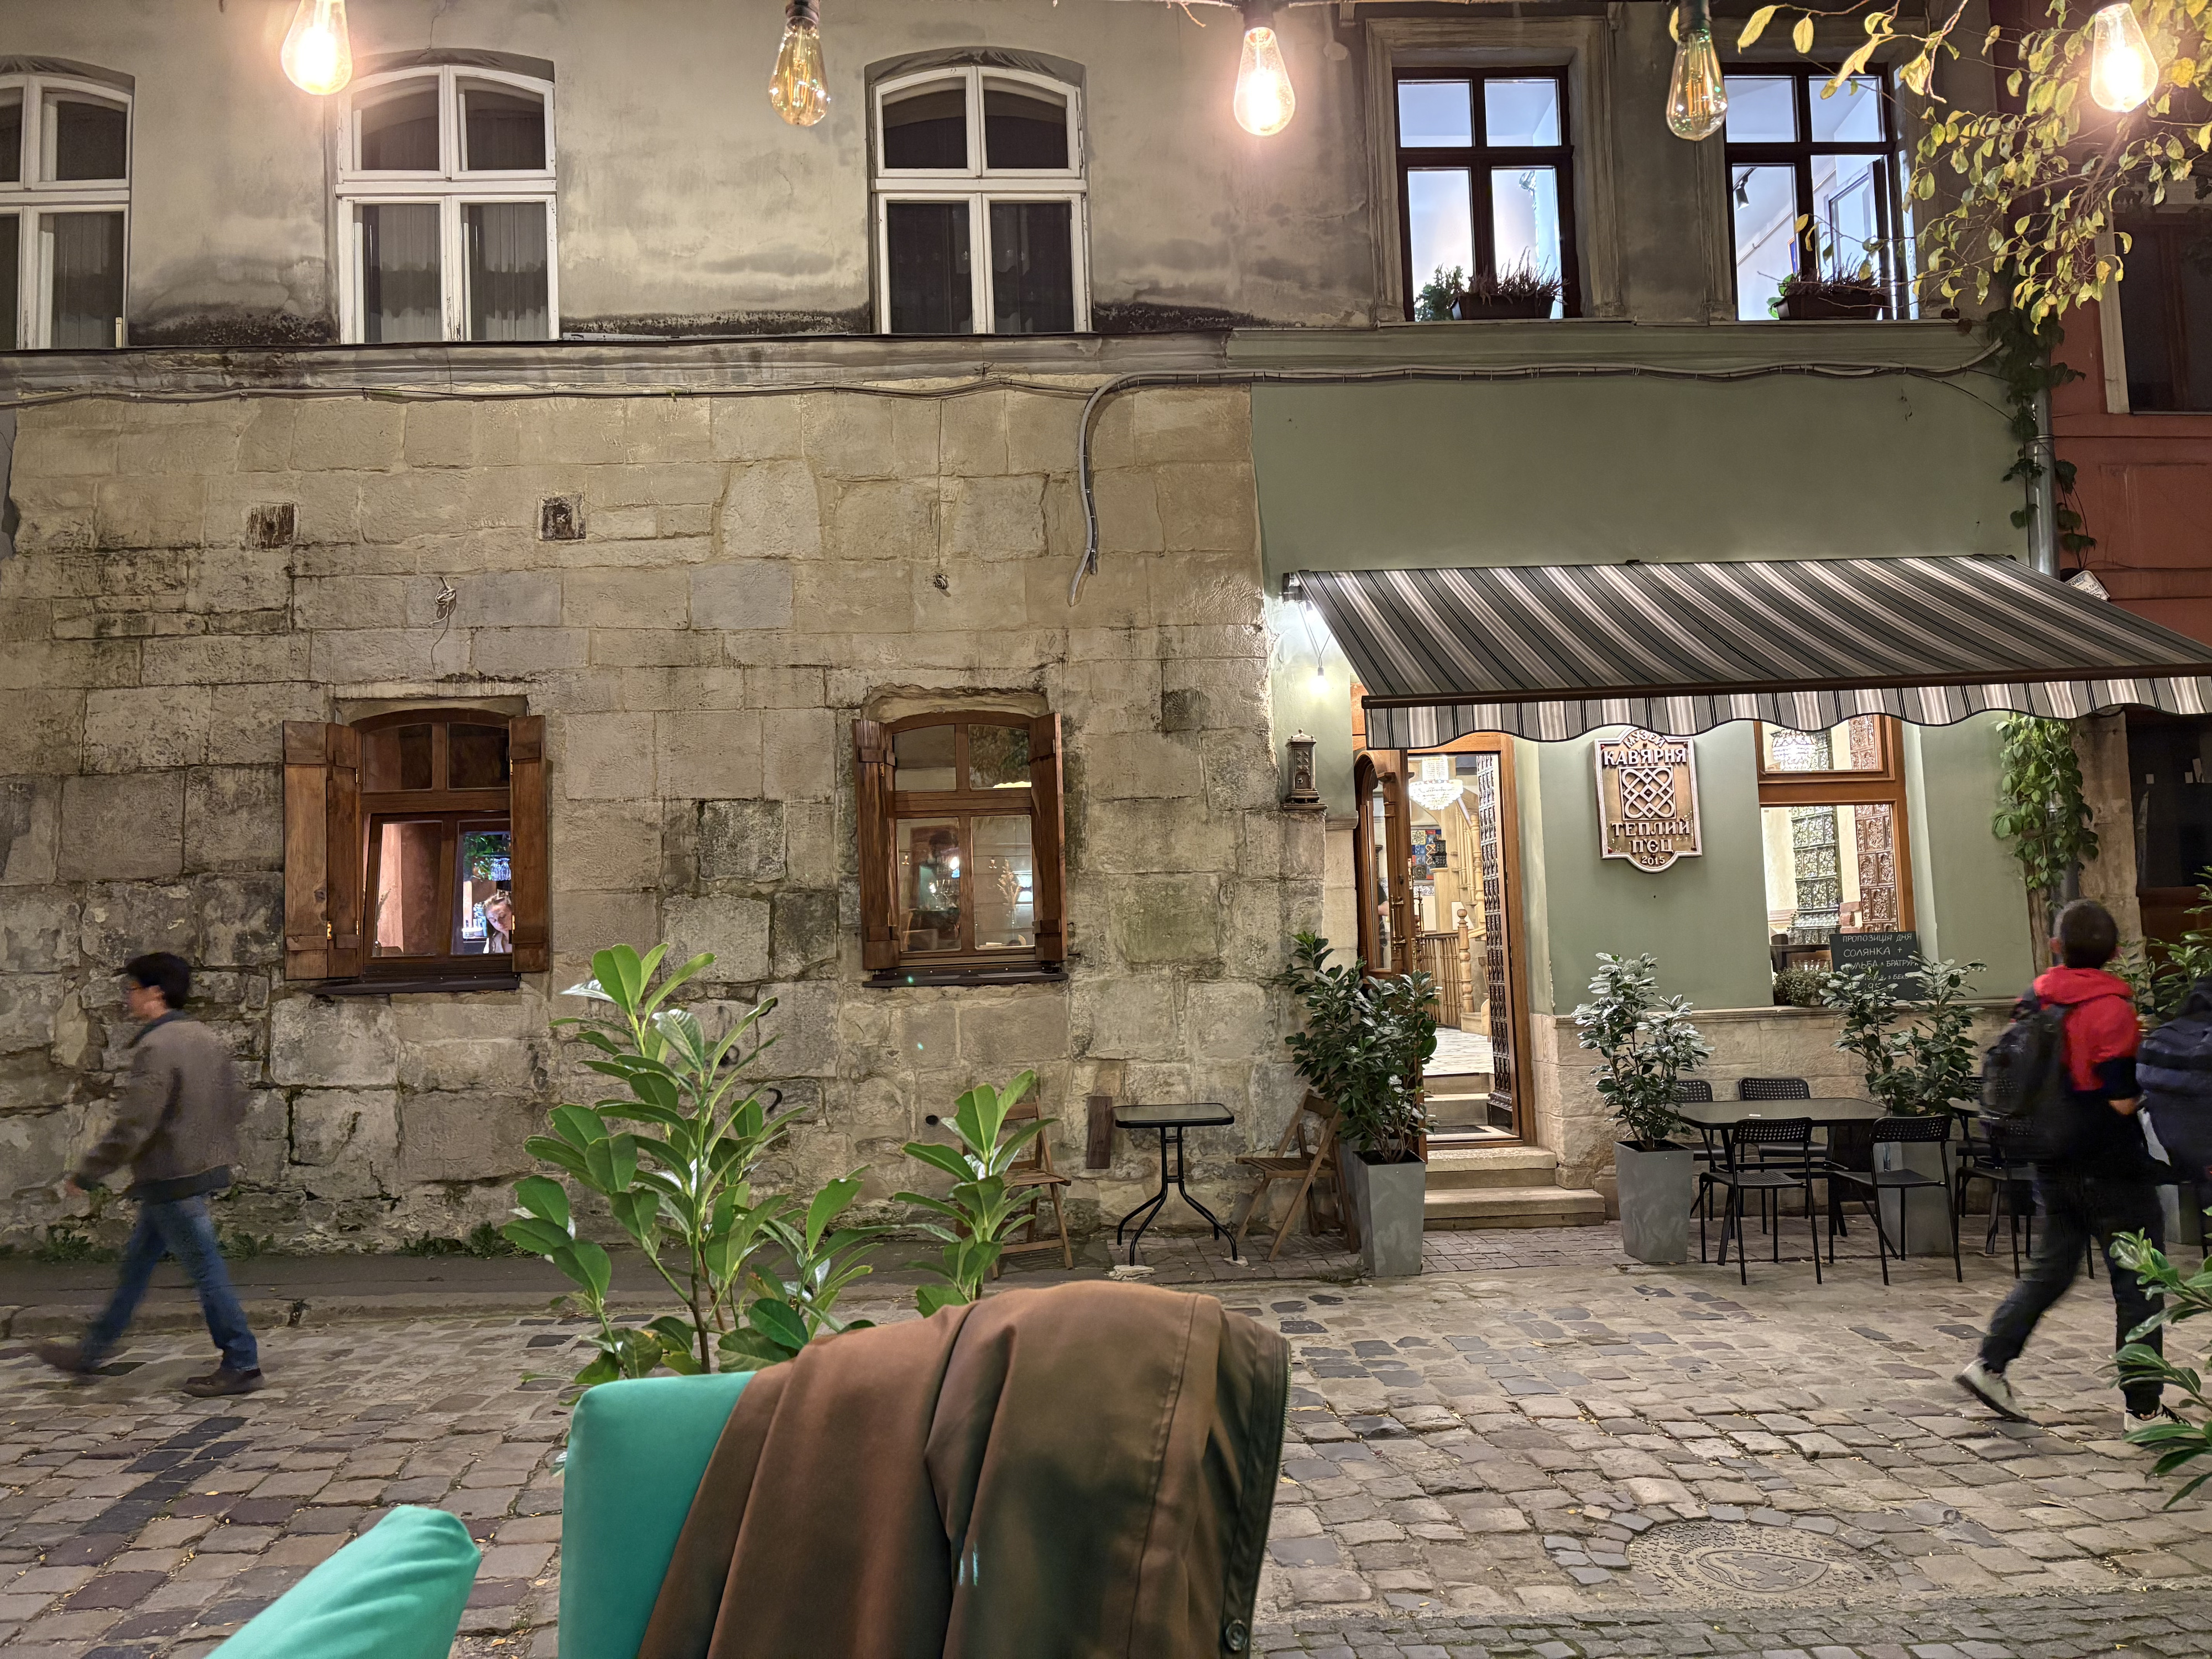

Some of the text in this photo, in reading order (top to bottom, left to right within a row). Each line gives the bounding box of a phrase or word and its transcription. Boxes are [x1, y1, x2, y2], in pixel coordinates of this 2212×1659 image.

[1624, 729, 1666, 748] МУЗЕЙ
[1604, 748, 1687, 765] КАВ'ЯРНЯ
[1611, 820, 1690, 836] ТЕПЛИЙ
[1641, 855, 1665, 865] 2015
[1843, 933, 1912, 943] ПРОПОЗИЦІЯ ДНЯ
[1843, 946, 1891, 957] СОЛЯНКА
[1850, 959, 1878, 970] УЛЬБА
